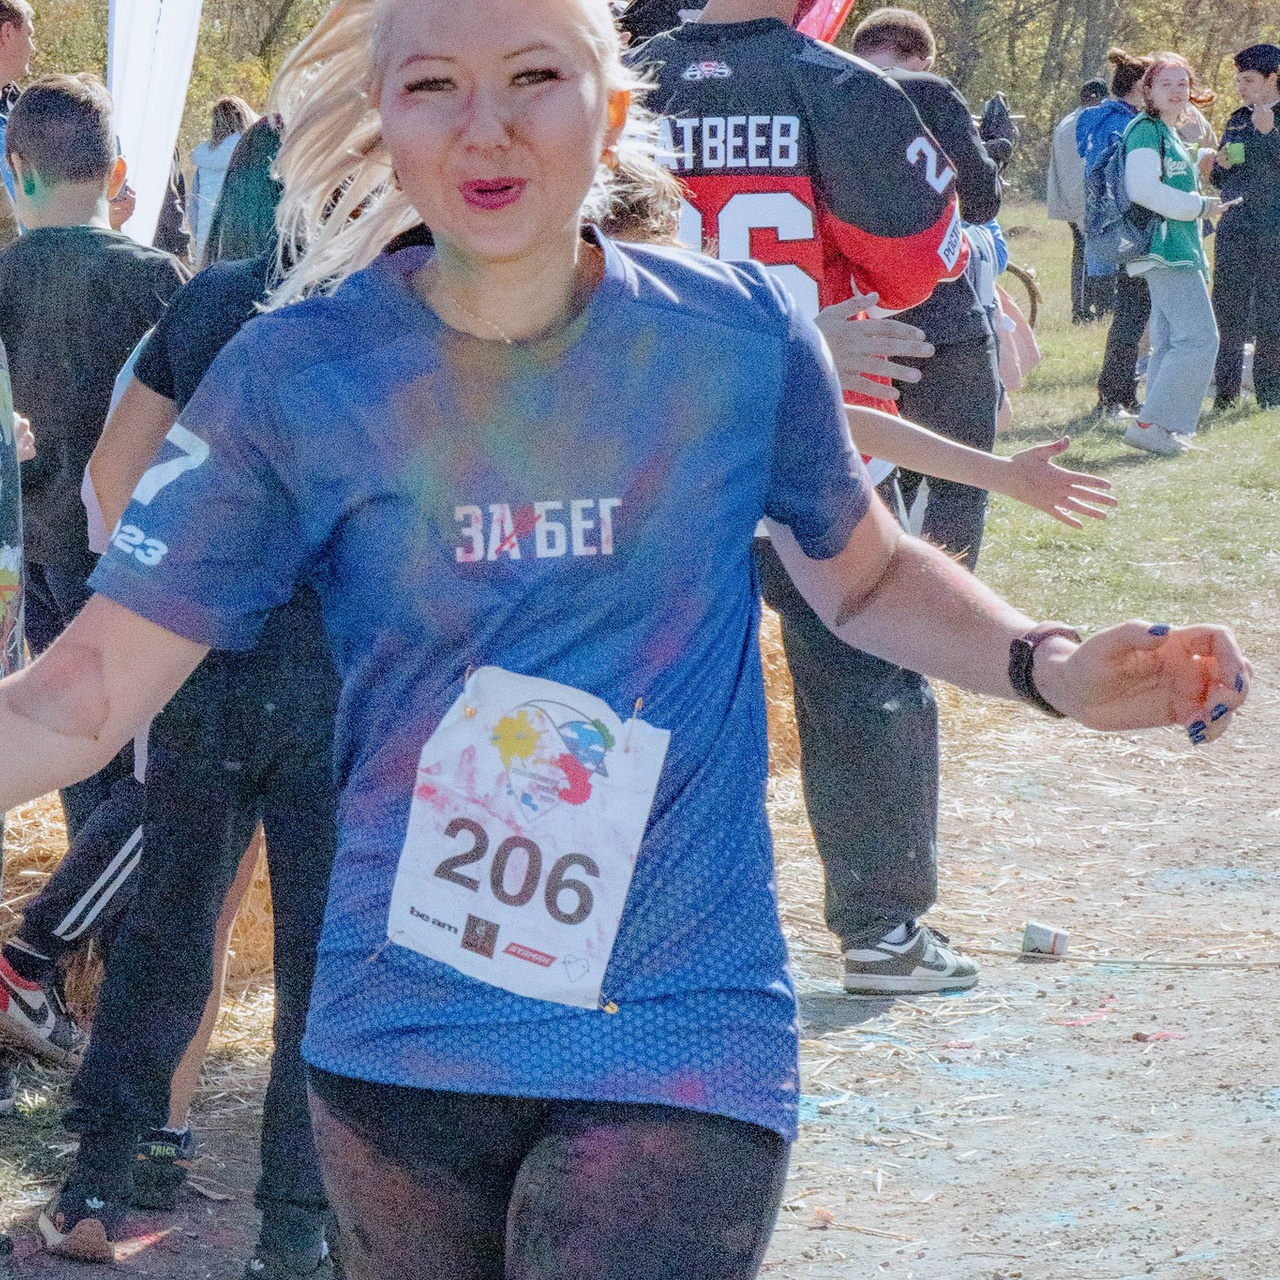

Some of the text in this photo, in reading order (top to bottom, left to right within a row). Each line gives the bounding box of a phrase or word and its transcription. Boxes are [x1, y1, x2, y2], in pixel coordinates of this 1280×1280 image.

[650, 115, 800, 170] АТВЕЕВ
[110, 519, 169, 565] 23
[433, 818, 600, 925] 206
